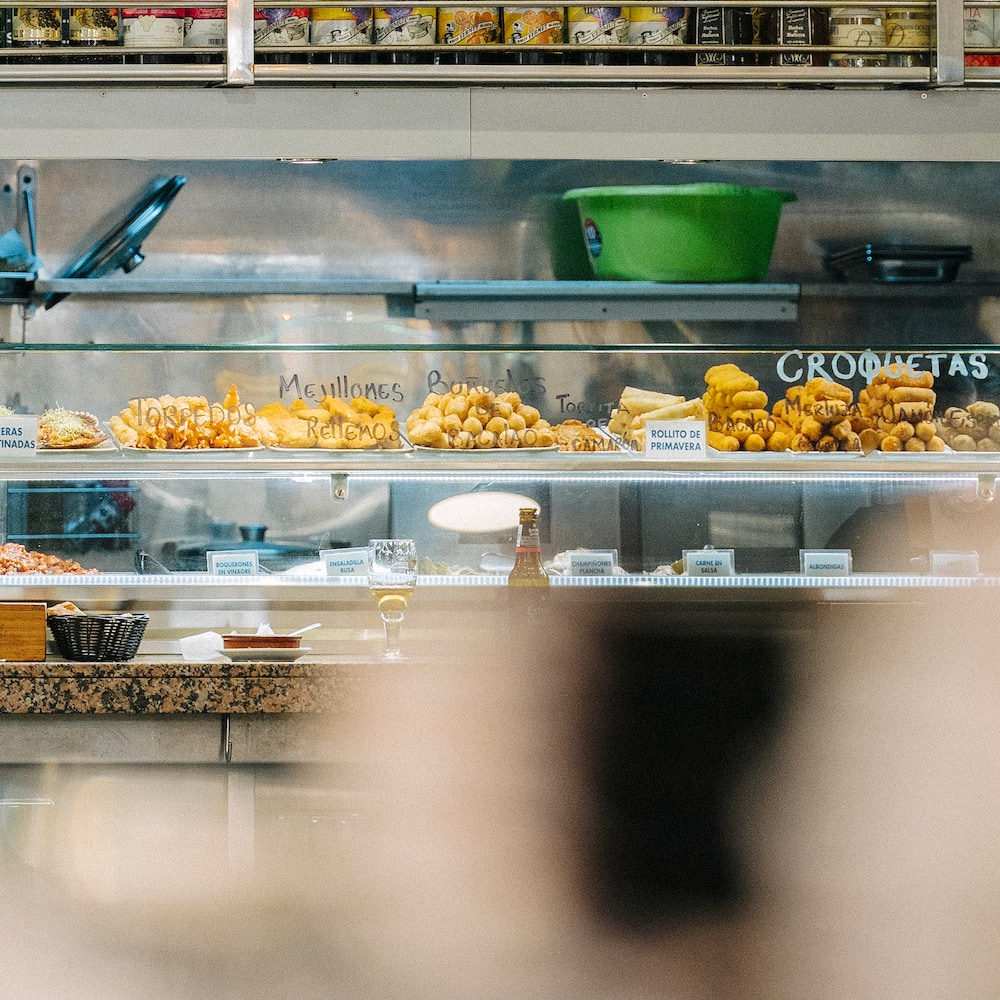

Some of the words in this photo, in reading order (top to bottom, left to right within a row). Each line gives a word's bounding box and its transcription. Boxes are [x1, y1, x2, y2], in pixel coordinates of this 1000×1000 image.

[776, 348, 989, 385] CROQUETAS
[651, 430, 686, 438] ROLLITO
[690, 430, 701, 438] DE
[651, 441, 701, 450] PRIMAVERA
[329, 559, 365, 568] ENSALADILLA
[571, 559, 612, 567] CHAMPIÑONES
[808, 563, 845, 571] ALBONDIGAS
